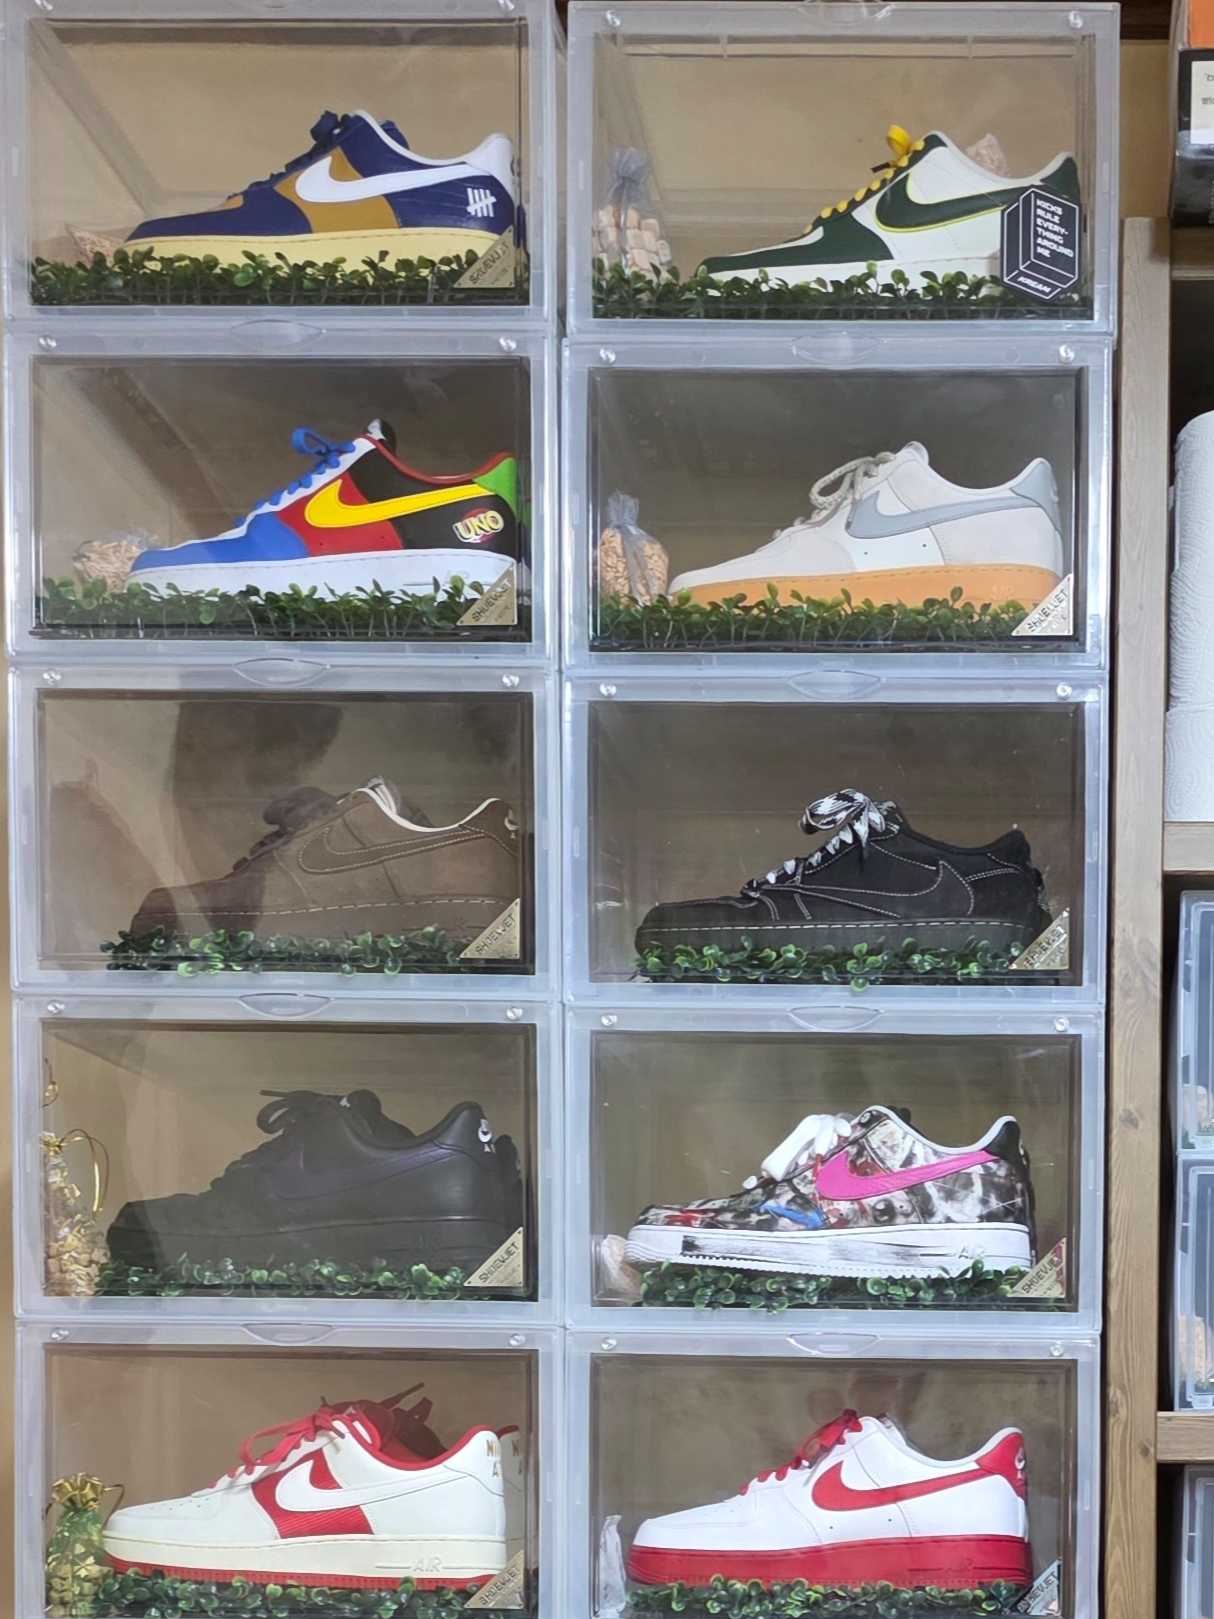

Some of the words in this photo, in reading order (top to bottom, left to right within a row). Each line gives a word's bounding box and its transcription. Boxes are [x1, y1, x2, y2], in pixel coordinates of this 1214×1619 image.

[1036, 199, 1062, 215] KICKS
[1036, 208, 1060, 223] RULE
[1036, 218, 1069, 235] EVERY-
[1036, 227, 1064, 244] THING
[1036, 237, 1074, 257] AROUND
[1037, 246, 1051, 257] ME
[1017, 276, 1051, 293] KREAM
[453, 510, 504, 542] UNO
[411, 1557, 442, 1573] AIR
